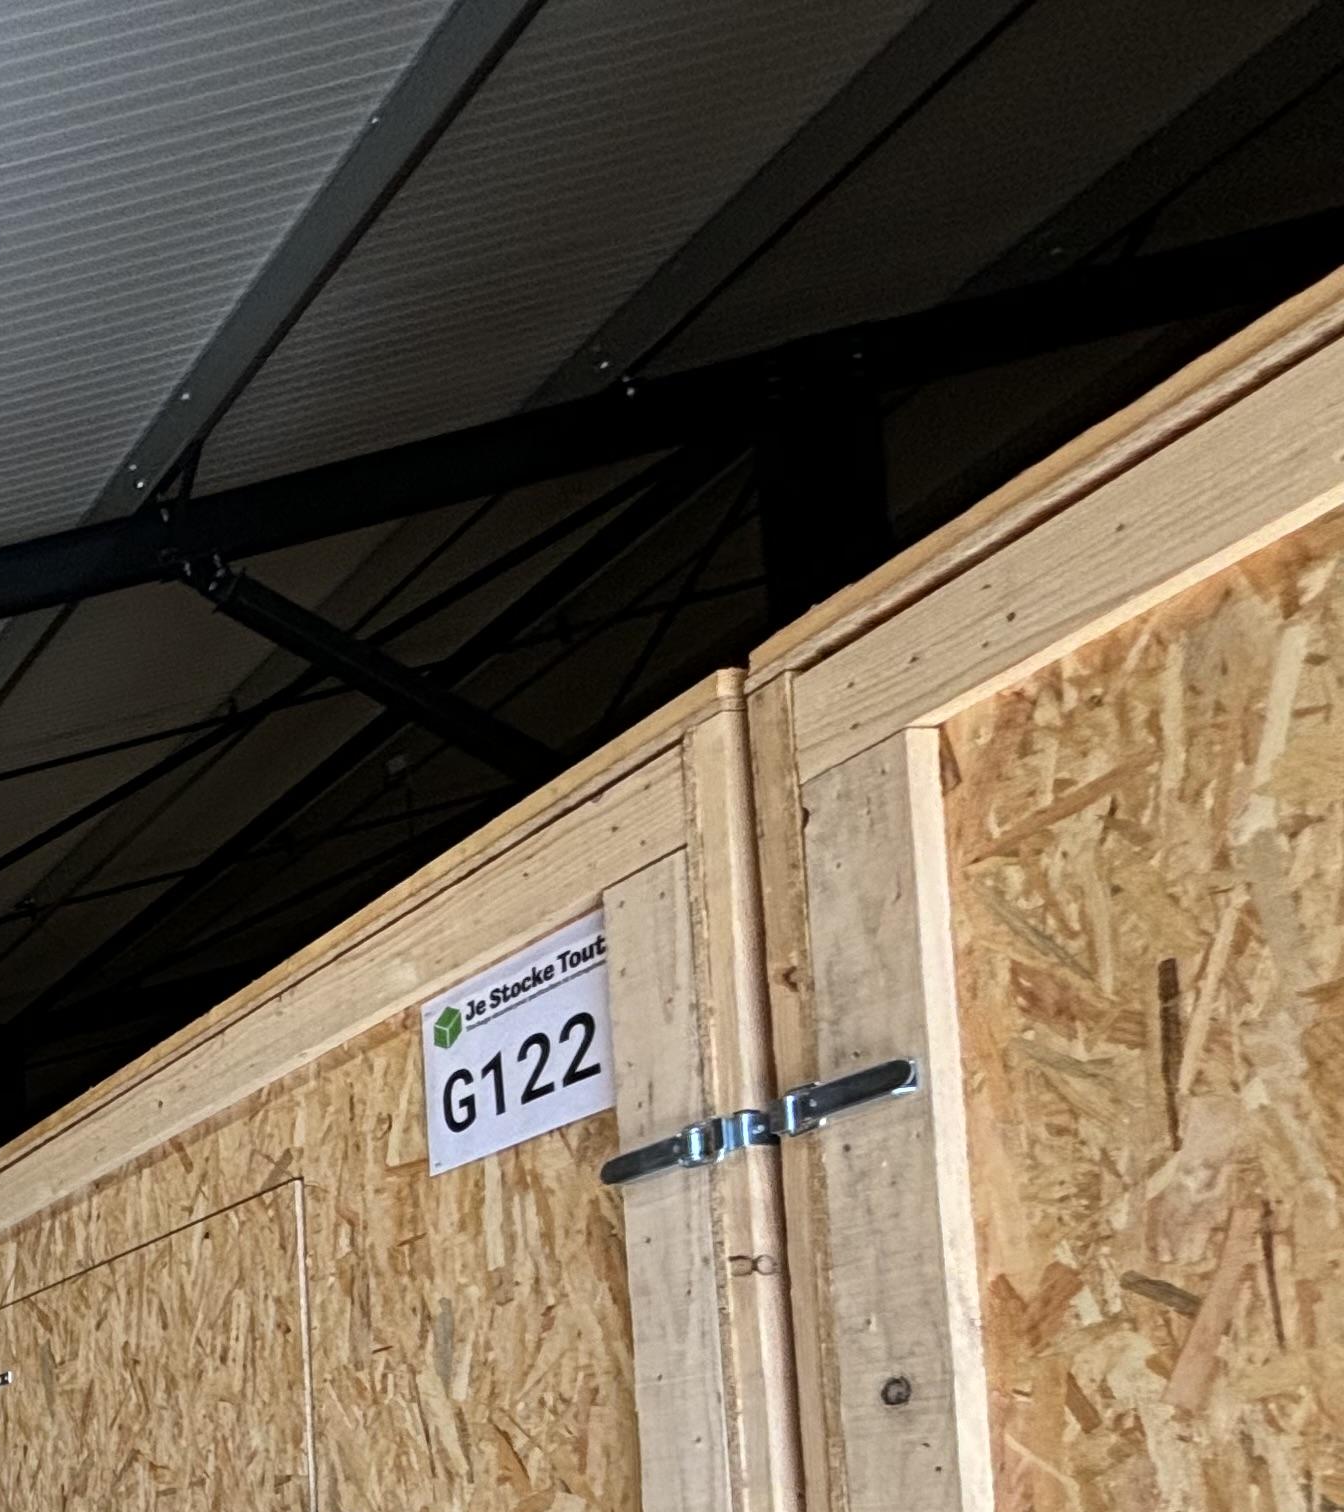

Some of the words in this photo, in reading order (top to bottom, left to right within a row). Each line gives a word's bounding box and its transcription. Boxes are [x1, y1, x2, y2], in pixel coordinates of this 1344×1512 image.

[465, 999, 487, 1021] Je
[489, 963, 556, 1009] Stocke
[556, 934, 607, 974] Tout
[443, 1011, 602, 1134] G122
